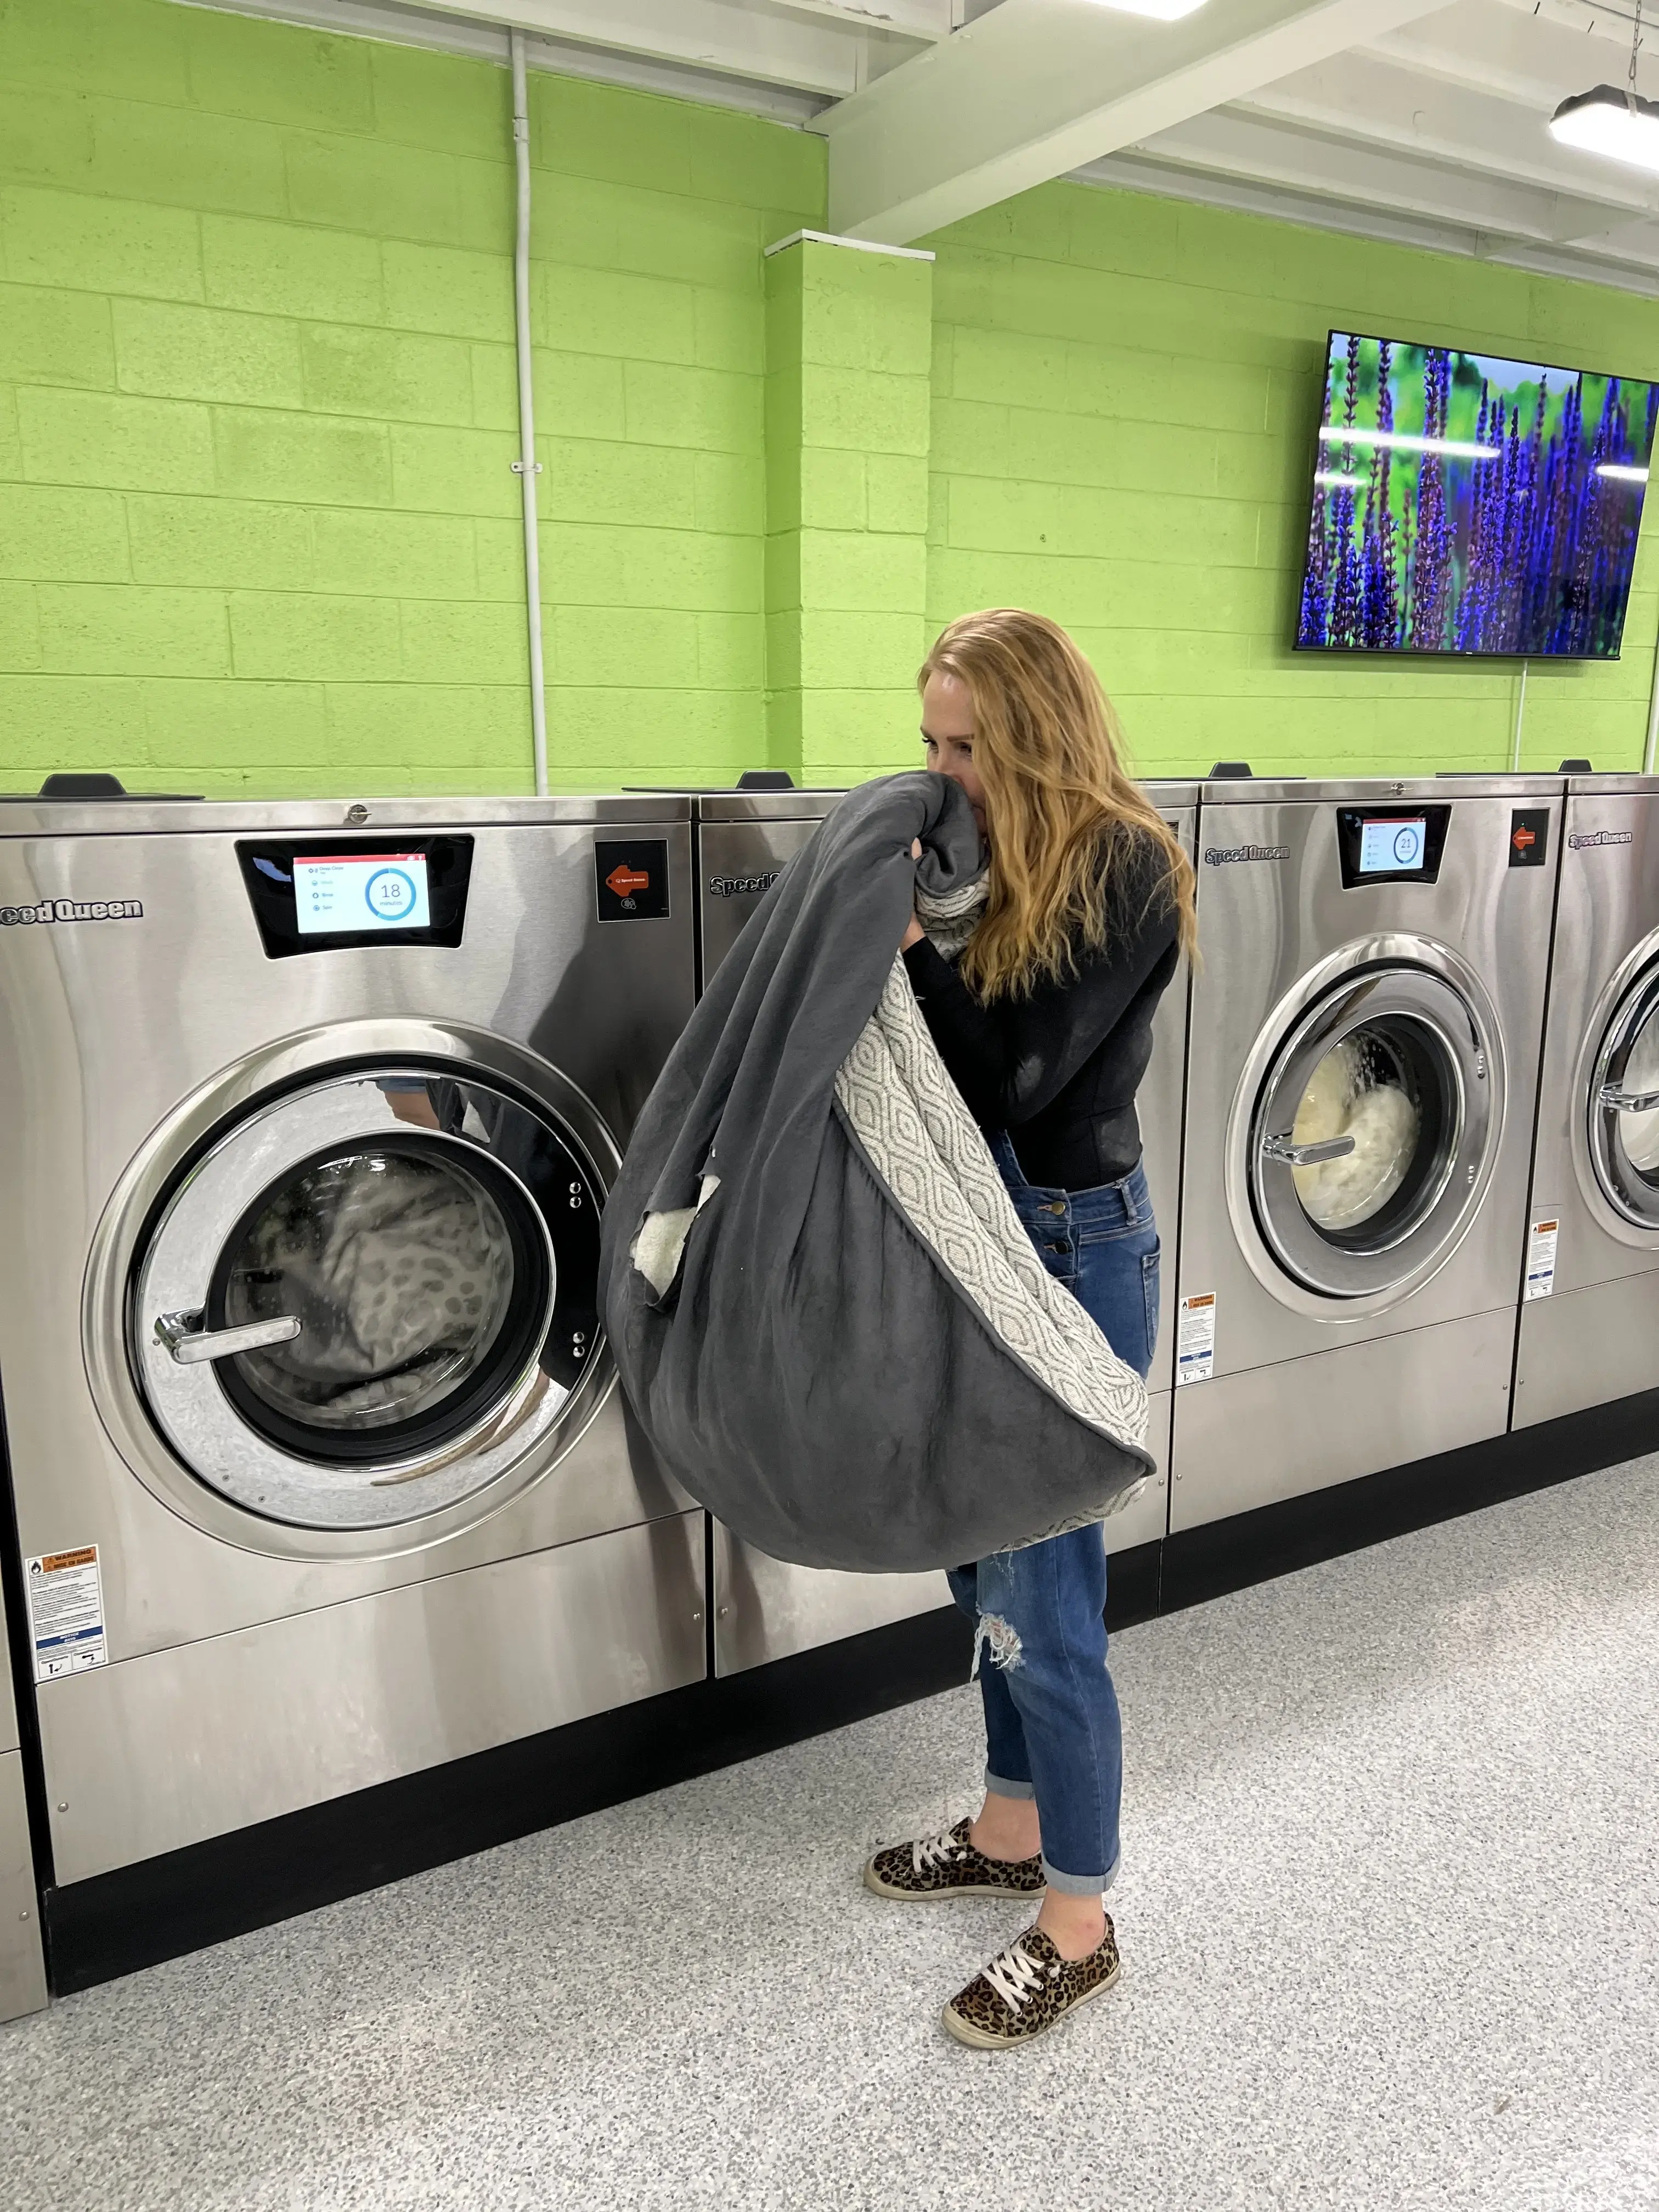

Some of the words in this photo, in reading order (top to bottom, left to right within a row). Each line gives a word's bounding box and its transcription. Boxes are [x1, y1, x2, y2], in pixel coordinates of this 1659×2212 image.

[1401, 838, 1411, 848] 21
[1569, 833, 1601, 849] Speed
[1601, 831, 1632, 844] Queen
[1205, 847, 1249, 866] Speed
[1249, 845, 1289, 860] Queen
[381, 884, 400, 898] 18
[710, 872, 769, 898] Speed
[55, 899, 143, 921] Queen
[55, 1549, 92, 1561] WARNING
